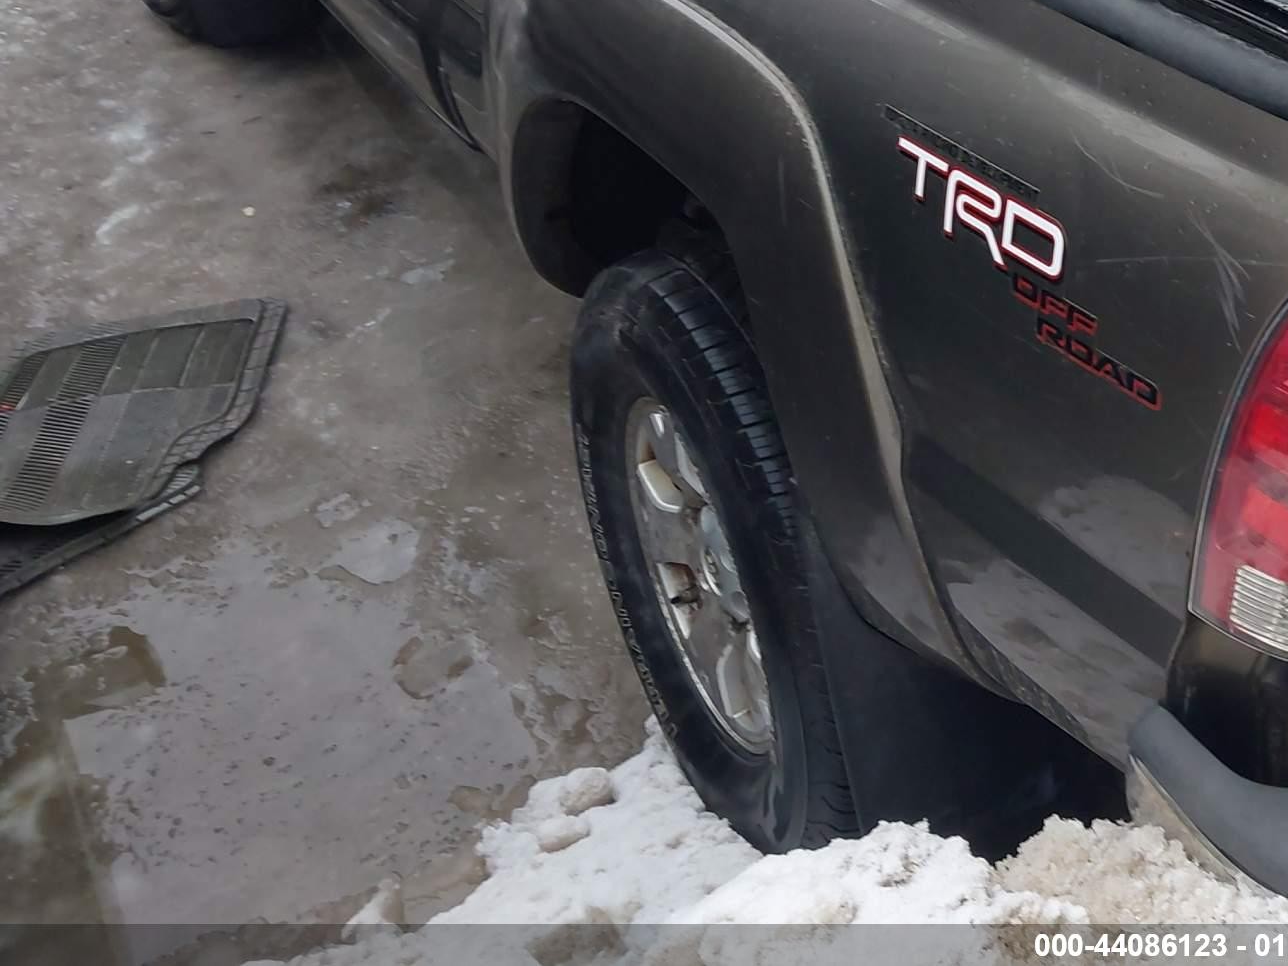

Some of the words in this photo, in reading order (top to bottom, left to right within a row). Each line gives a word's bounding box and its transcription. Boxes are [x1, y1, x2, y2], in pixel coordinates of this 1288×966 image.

[896, 135, 1067, 282] TRD
[1011, 273, 1099, 337] OFF
[1036, 316, 1163, 412] ROAD
